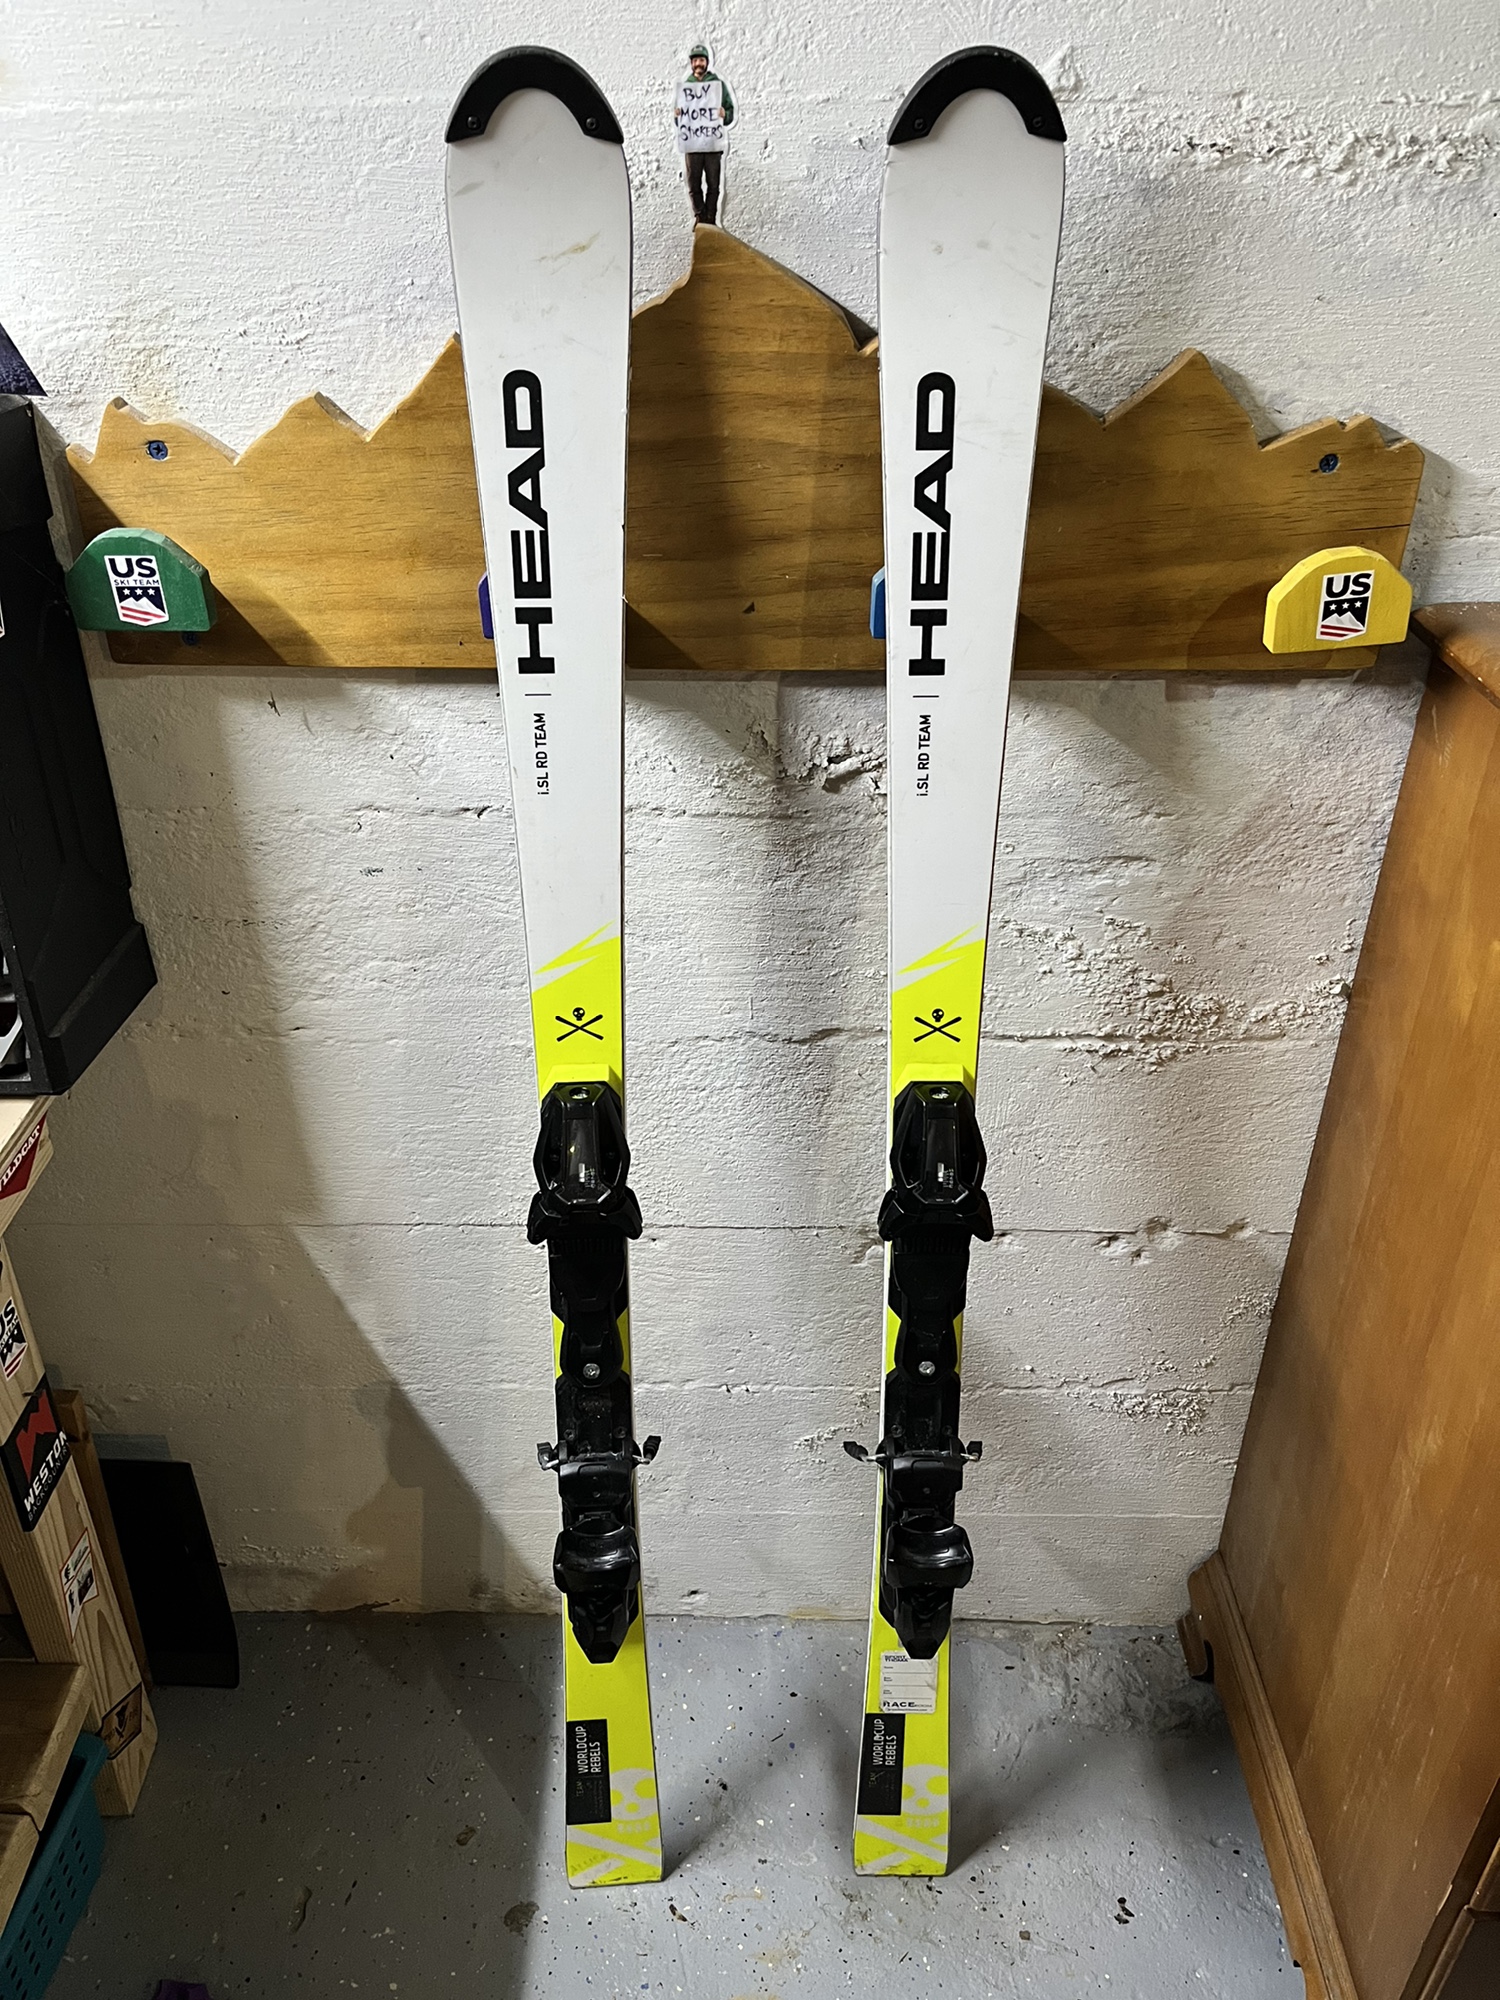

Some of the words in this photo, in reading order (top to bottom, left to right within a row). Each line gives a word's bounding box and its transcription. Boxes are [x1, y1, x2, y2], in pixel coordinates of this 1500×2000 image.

[683, 84, 711, 102] BUY
[680, 107, 720, 122] MORE
[502, 369, 556, 675] HEAD
[908, 371, 956, 676] HEAD
[108, 557, 157, 578] US
[1325, 573, 1373, 599] US
[533, 712, 547, 749] TEAM
[918, 714, 932, 750] TEAM
[535, 751, 549, 769] RD
[917, 752, 930, 770] RD
[536, 771, 550, 795] i.SL
[916, 773, 929, 797] i.SL
[0, 1124, 40, 1192] ILDCAT
[24, 1429, 67, 1512] WESTON
[575, 1725, 589, 1774] WORLDCUP
[589, 1741, 602, 1773] REBELS
[872, 1718, 885, 1766] WORLDCUP
[885, 1734, 897, 1766] REBELS
